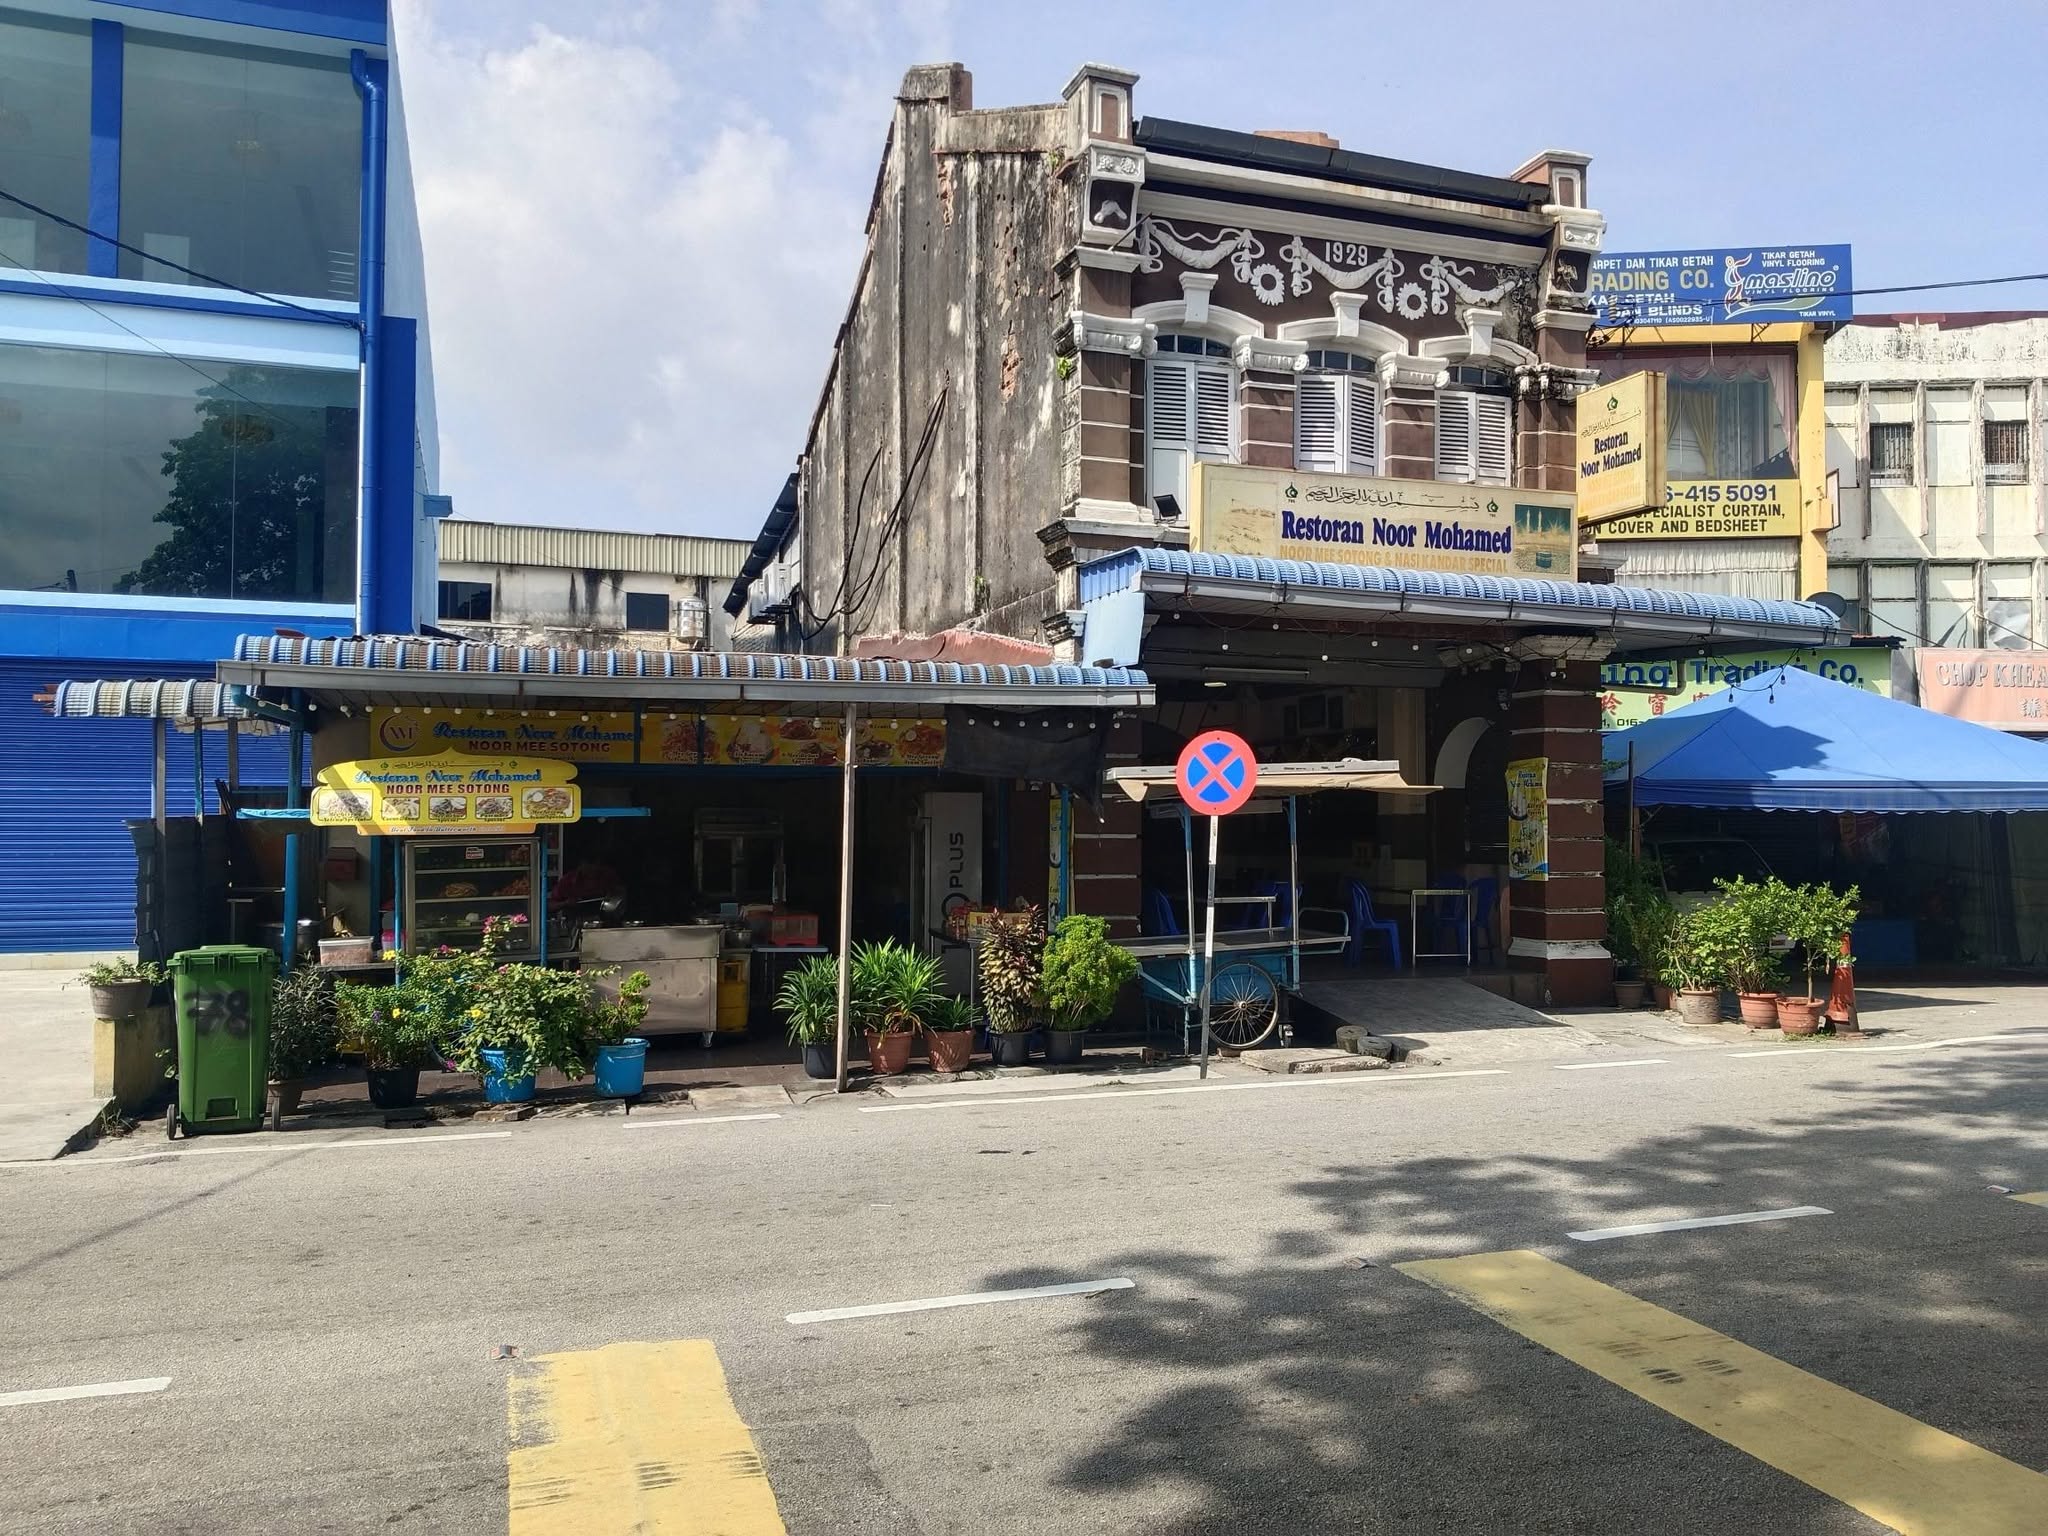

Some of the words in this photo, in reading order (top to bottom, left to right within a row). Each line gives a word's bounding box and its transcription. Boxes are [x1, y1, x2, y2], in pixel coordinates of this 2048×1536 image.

[1325, 241, 1368, 267] 1929
[1626, 258, 1646, 269] DAN
[1650, 257, 1679, 268] TIKAR
[1682, 255, 1714, 267] GETAH
[1762, 252, 1786, 260] TIKAR
[1789, 250, 1815, 259] GETAH
[1762, 260, 1785, 268] VINYL
[1787, 258, 1826, 267] FLOORING
[1591, 271, 1670, 292] RADING
[1680, 269, 1715, 290] CO.
[1648, 304, 1703, 317] BLINDS
[1594, 431, 1629, 455] Restoran
[1580, 460, 1600, 478] Noor
[1602, 442, 1642, 472] Mohamed
[1726, 484, 1777, 501] 5091
[1722, 503, 1786, 519] CURTAIN,
[1280, 510, 1365, 545] Restoran
[1372, 517, 1417, 547] Noor
[1424, 521, 1512, 554] Mohamed
[1608, 521, 1654, 534] COVER
[1660, 519, 1689, 533] AND
[1695, 518, 1768, 532] BEDSHEET
[1280, 545, 1313, 560] NOOR
[1314, 548, 1336, 563] MEE
[1337, 549, 1381, 566] SOTONG
[1384, 552, 1393, 566] &
[1394, 552, 1420, 568] NASI
[1421, 554, 1465, 570] KANDAR
[1468, 557, 1509, 573] SPECIAL
[1601, 665, 1671, 688] ing
[1819, 659, 1864, 684] Co.
[1936, 662, 1989, 687] CHOP
[432, 721, 508, 740] Restoran
[516, 724, 556, 741] Noor
[468, 740, 512, 752] NOOR
[516, 741, 548, 752] MEE
[549, 742, 610, 753] SOTONG
[354, 769, 419, 782] Restoran
[425, 769, 464, 782] Noor
[468, 768, 542, 782] Mohamed
[386, 785, 423, 795] NOOR
[427, 784, 453, 794] MEE
[457, 783, 510, 794] SOTONG
[950, 832, 964, 888] PLUS
